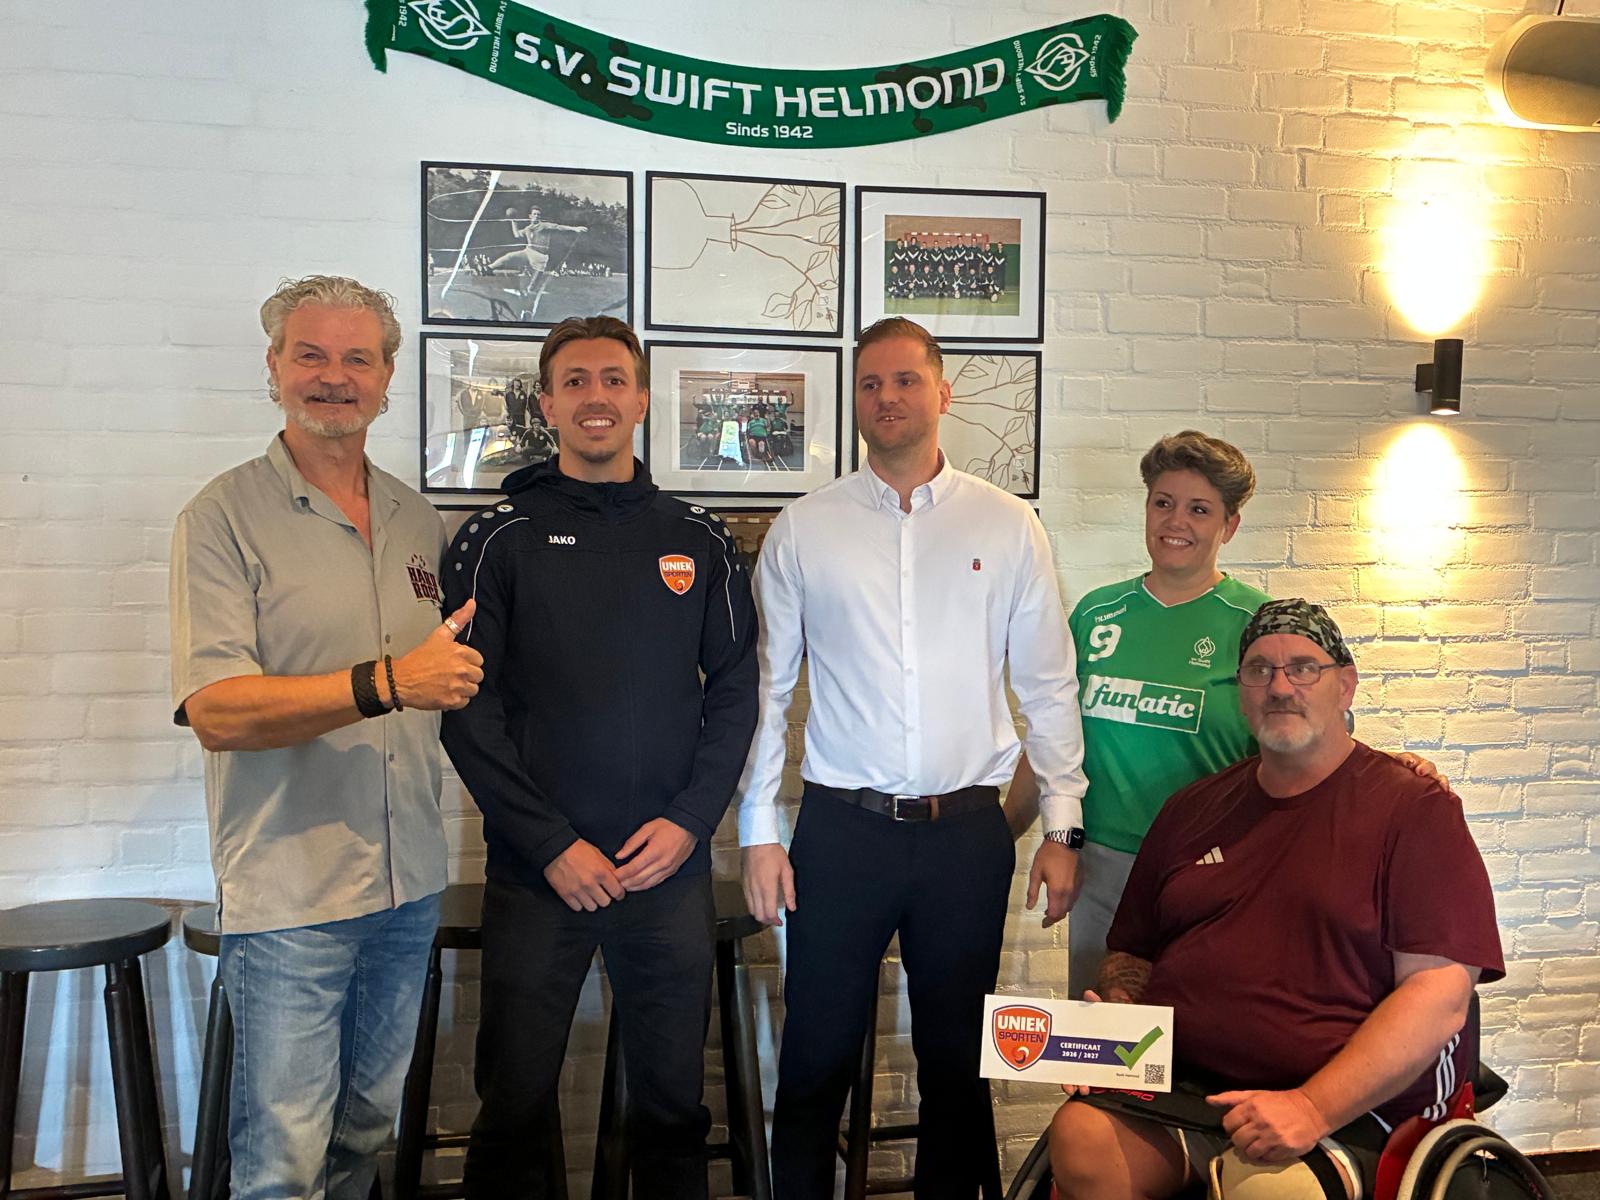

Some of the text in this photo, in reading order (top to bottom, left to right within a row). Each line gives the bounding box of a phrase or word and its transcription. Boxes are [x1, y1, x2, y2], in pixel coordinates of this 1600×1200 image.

[398, 5, 407, 27] 1942
[489, 36, 501, 73] HELMOND
[514, 32, 1005, 118] S.V. SWIFT HELMOND
[726, 122, 814, 139] Sinds 1942
[548, 535, 576, 545] JAKO
[661, 561, 693, 571] UNIEK
[1088, 624, 1122, 662] 9
[1085, 683, 1196, 719] funatic
[997, 1015, 1047, 1033] UNIEK
[998, 1031, 1045, 1044] SPORTEN
[1060, 1041, 1102, 1052] CERTIFICAAT
